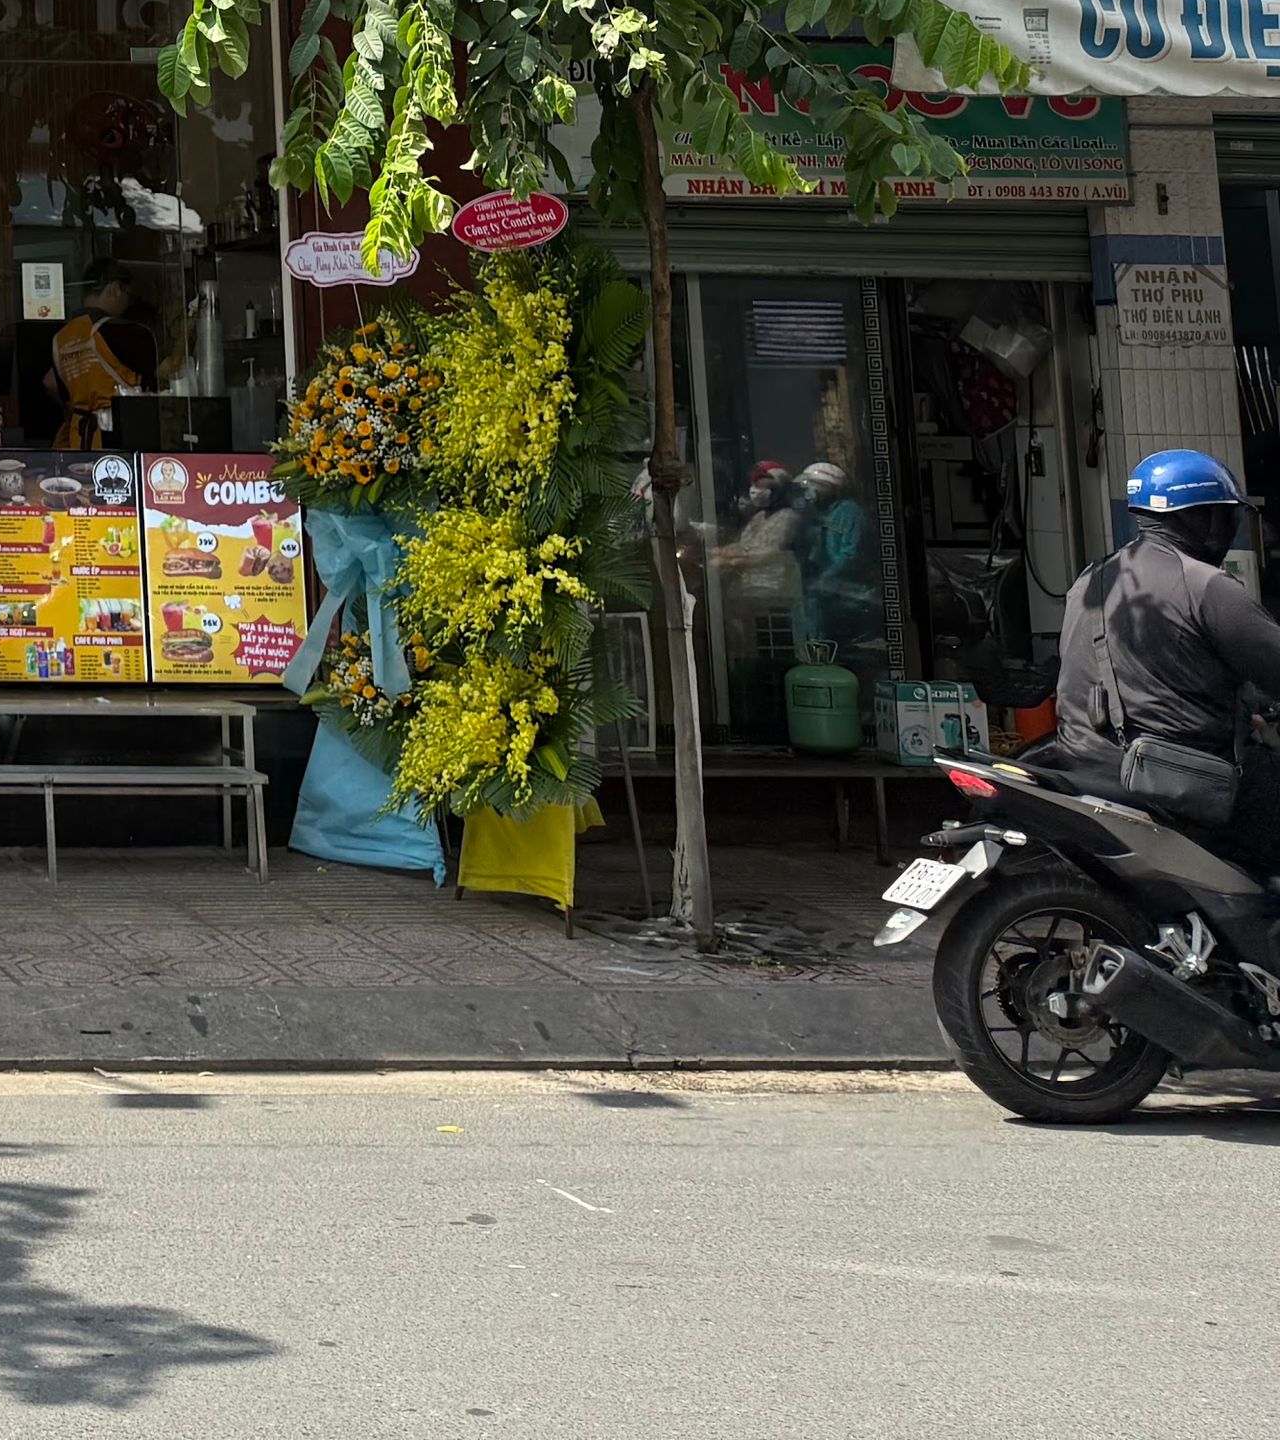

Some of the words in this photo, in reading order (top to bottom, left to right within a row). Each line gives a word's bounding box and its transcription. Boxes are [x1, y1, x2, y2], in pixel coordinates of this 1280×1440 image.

[973, 136, 1004, 149] Mua
[1041, 135, 1069, 149] Các
[1066, 157, 1080, 170] VI
[1083, 156, 1124, 171] SÓNG
[996, 185, 1025, 198] 0908
[1030, 186, 1053, 198] 443
[1057, 186, 1079, 198] 870
[1136, 267, 1197, 286] NHẬN
[1131, 287, 1166, 305] THỢ
[1172, 289, 1204, 305] PHỤ
[1123, 308, 1148, 325] THỢ
[1153, 306, 1183, 326] ĐIỆN
[1188, 310, 1221, 326] LẠNH
